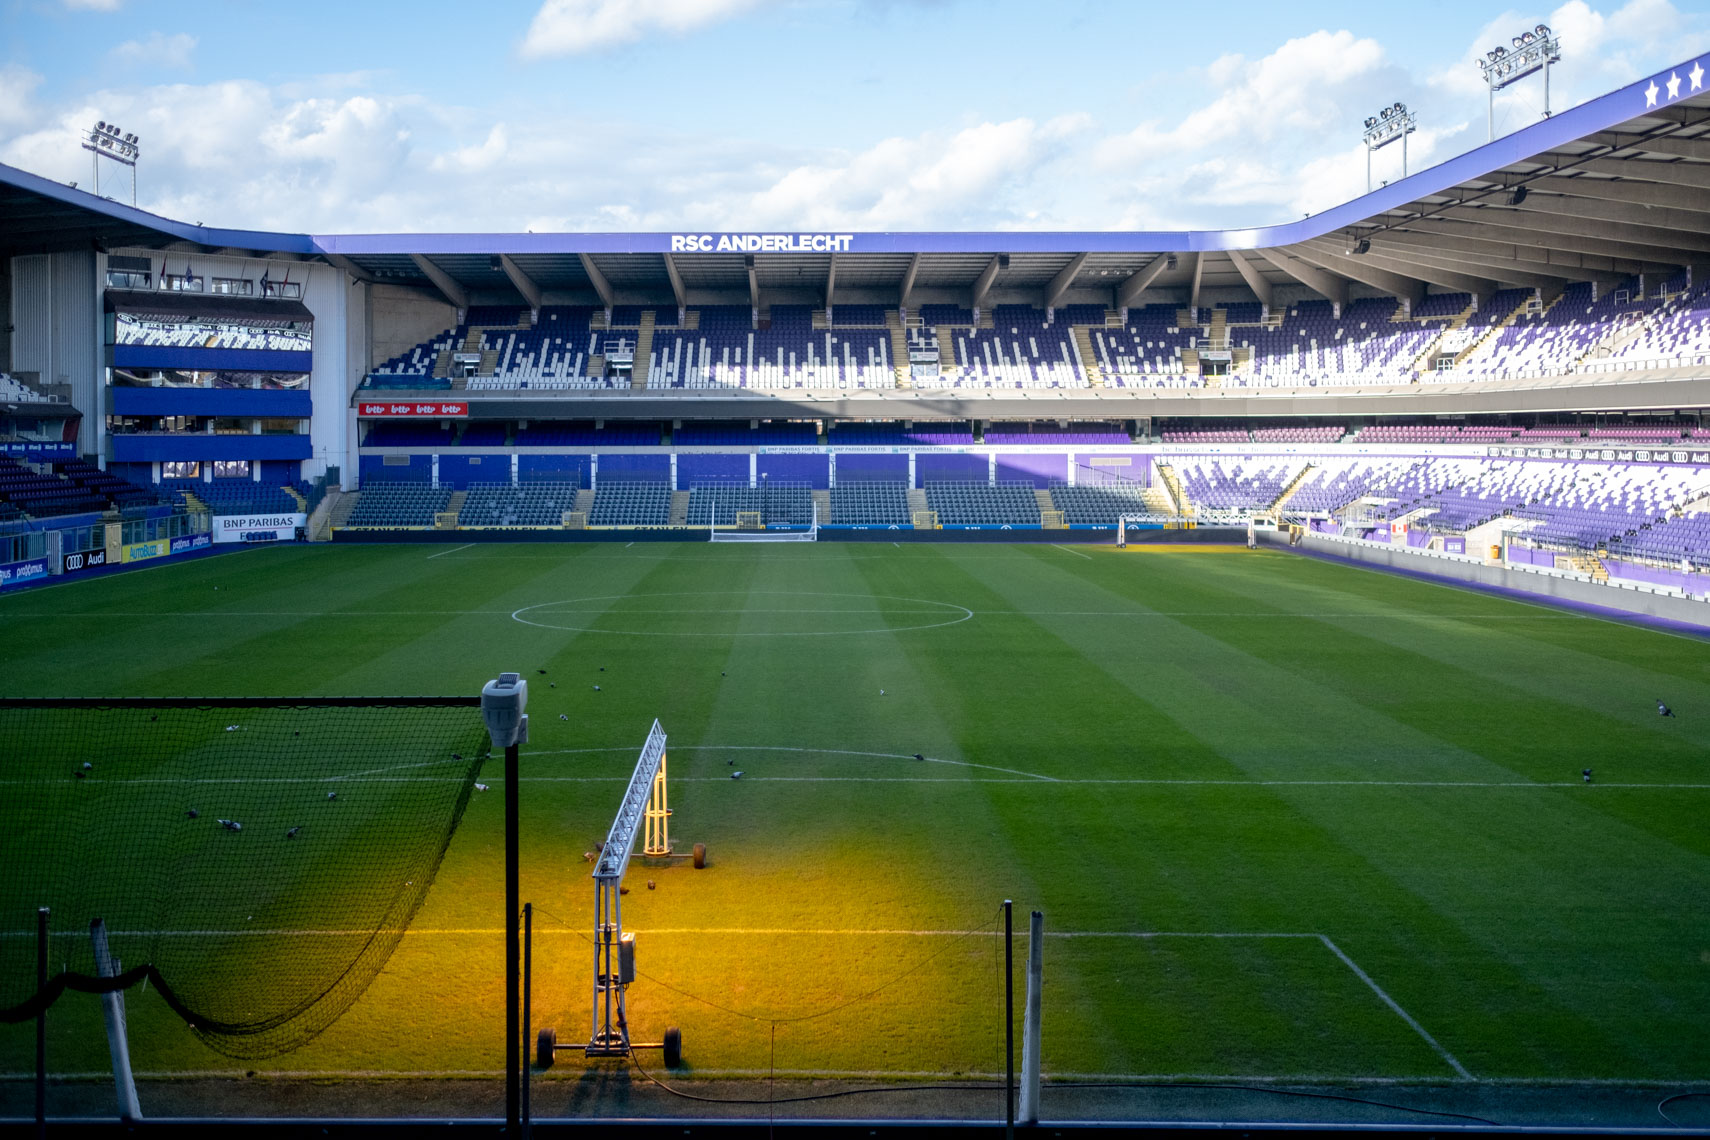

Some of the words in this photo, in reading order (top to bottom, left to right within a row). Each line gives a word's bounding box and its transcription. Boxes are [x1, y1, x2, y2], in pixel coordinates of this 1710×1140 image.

[671, 235, 713, 251] RSC
[716, 235, 853, 251] ANDERLECHT
[365, 404, 385, 414] lotto
[390, 404, 410, 414] lotto
[416, 404, 436, 414] lotto
[441, 404, 461, 414] lotto
[1585, 450, 1599, 460] Audi
[1618, 450, 1633, 461] Audi
[1653, 451, 1669, 462] Audi
[1692, 452, 1709, 463] Audi
[223, 519, 246, 528] BNP
[248, 517, 293, 527] PARIBAS
[88, 551, 105, 566] Audi
